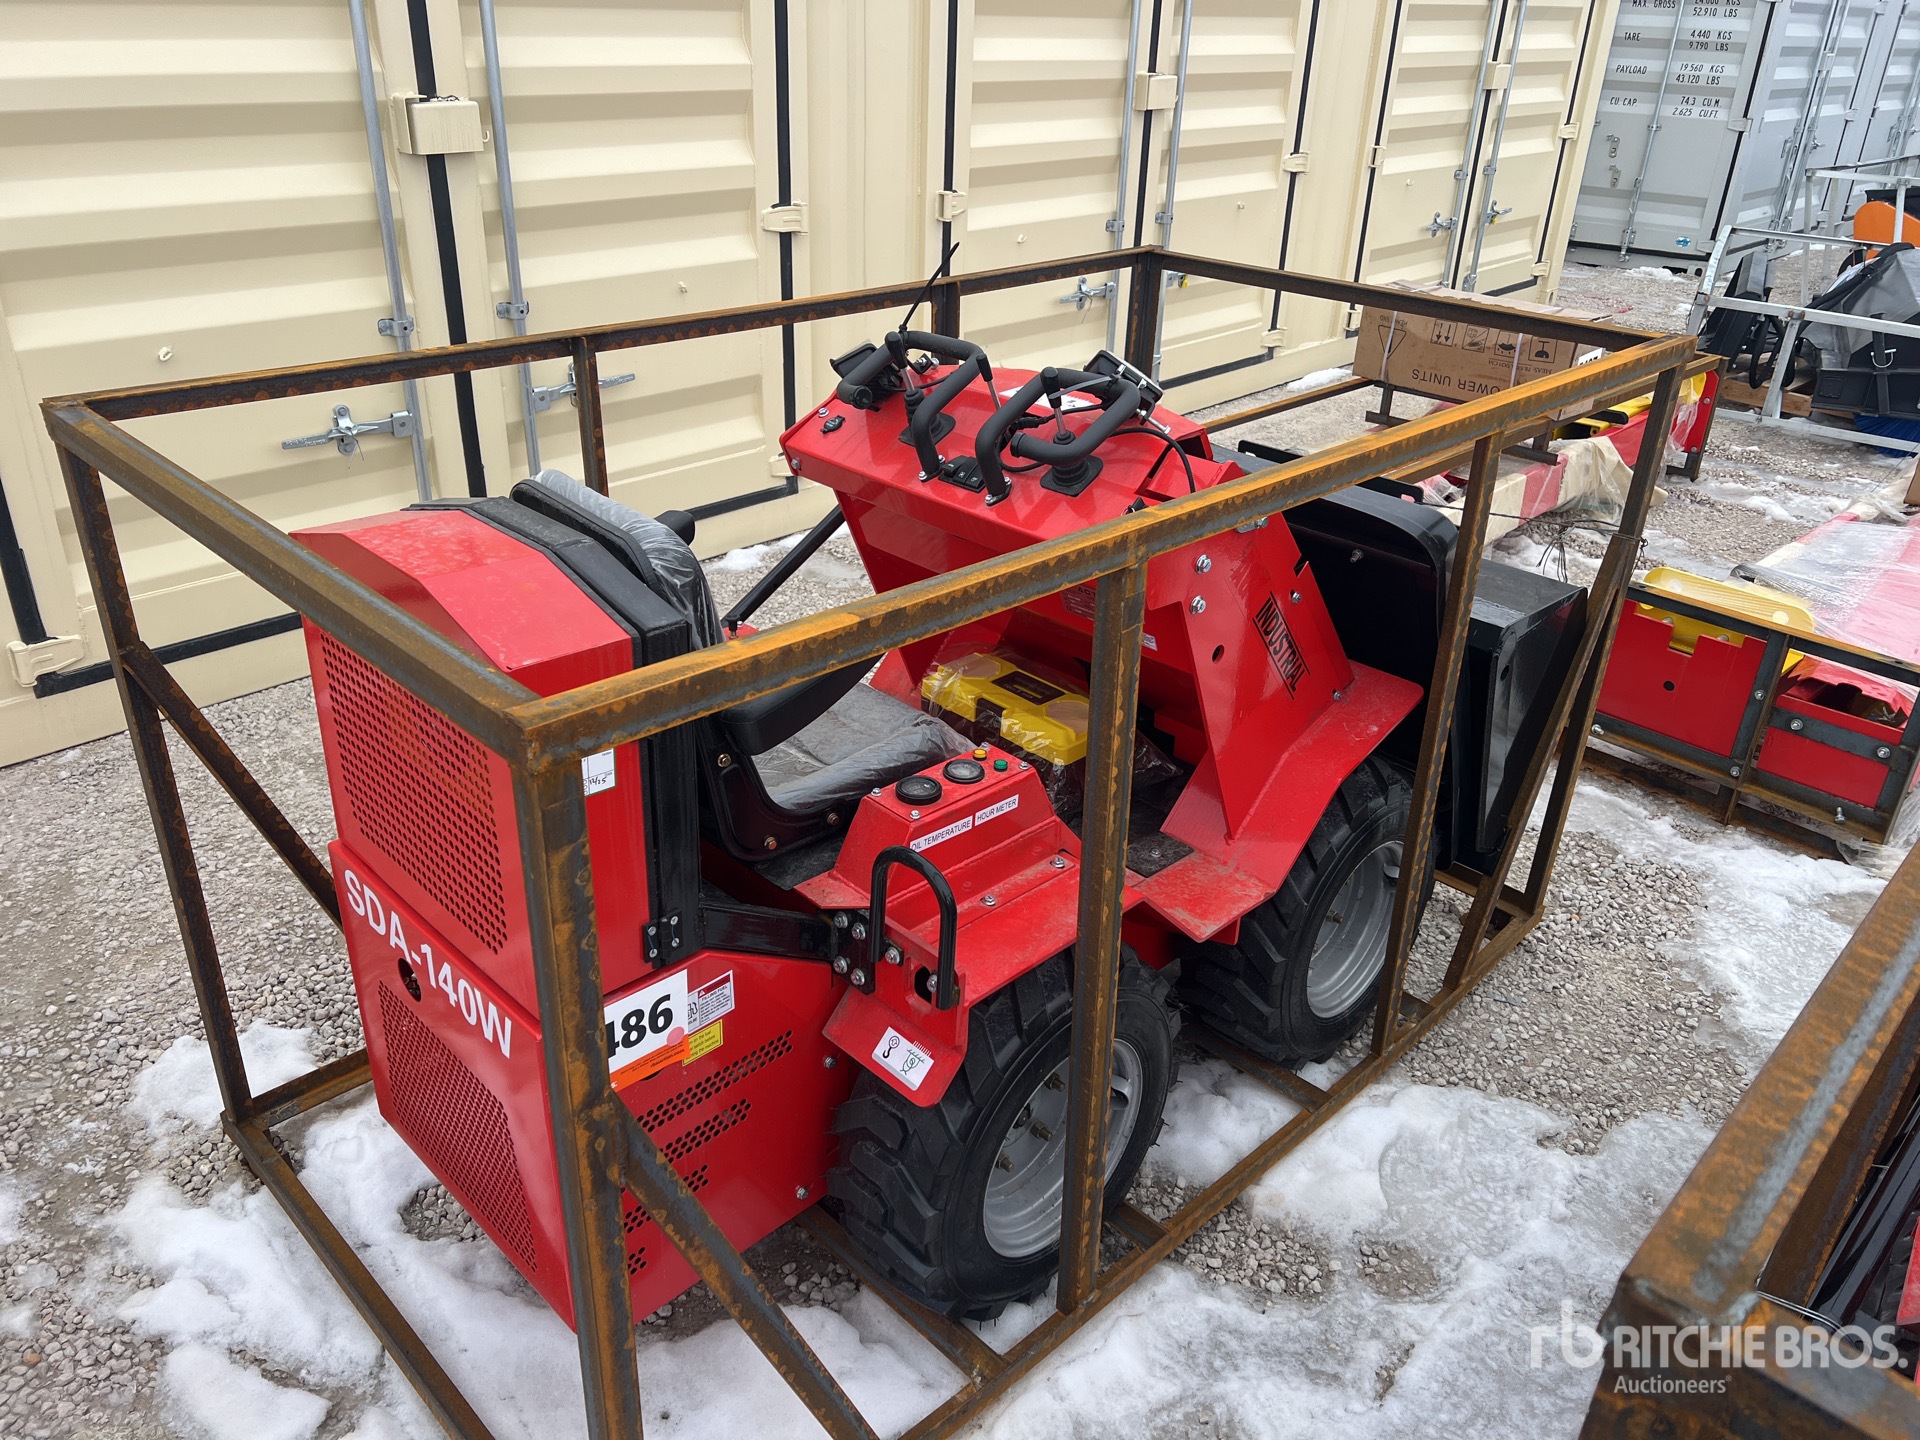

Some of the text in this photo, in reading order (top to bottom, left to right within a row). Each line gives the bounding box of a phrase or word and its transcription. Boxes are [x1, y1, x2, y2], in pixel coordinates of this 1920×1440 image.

[1653, 0, 1676, 9] GROSS
[1692, 7, 1738, 18] 52.910 LBS
[1624, 32, 1641, 42] TARE
[1690, 30, 1733, 41] 4.440 KGS
[1689, 41, 1729, 52] 9.790 LBS
[1615, 64, 1648, 75] PAYLOAD
[1679, 63, 1725, 74] 19.560 KGS
[1675, 74, 1721, 86] 43.120 LBS
[1680, 96, 1697, 106] 74.3
[1672, 107, 1693, 117] 2.625
[1411, 368, 1501, 396] OWER UNITS
[1255, 596, 1306, 693] INDUSTRIAL
[977, 798, 1017, 822] HOUR METER
[911, 819, 971, 852] OIL TEMPERATURE
[344, 869, 512, 1059] SDA-140W
